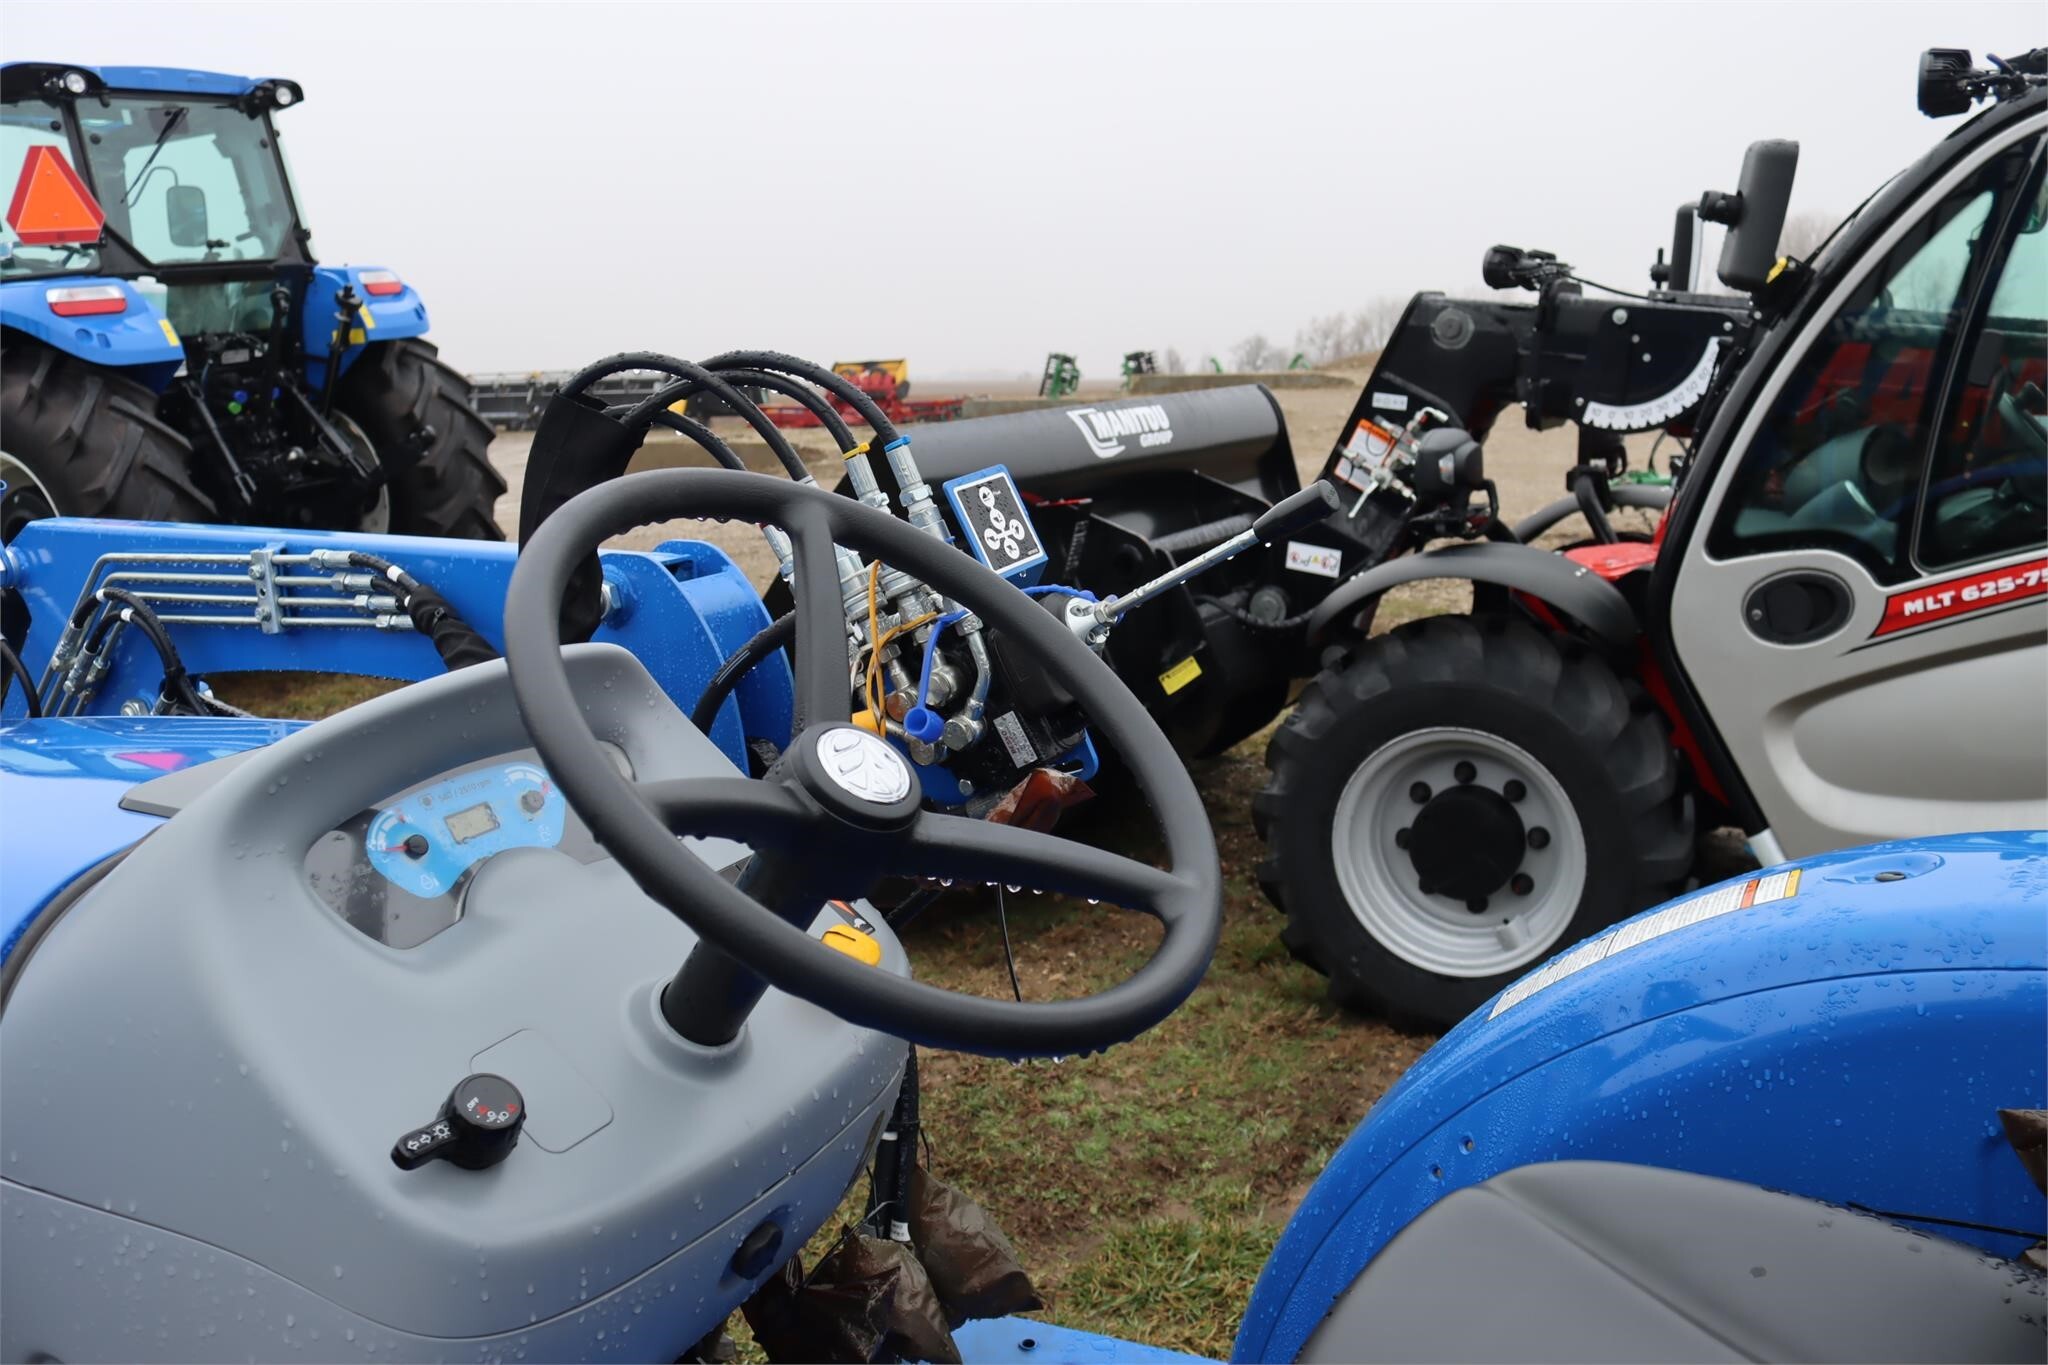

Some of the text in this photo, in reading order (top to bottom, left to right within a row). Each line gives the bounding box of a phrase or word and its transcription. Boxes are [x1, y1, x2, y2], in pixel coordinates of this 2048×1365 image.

[1087, 405, 1170, 440] MANITOU
[1903, 591, 1956, 616] MLT
[466, 1096, 479, 1109] OFF
